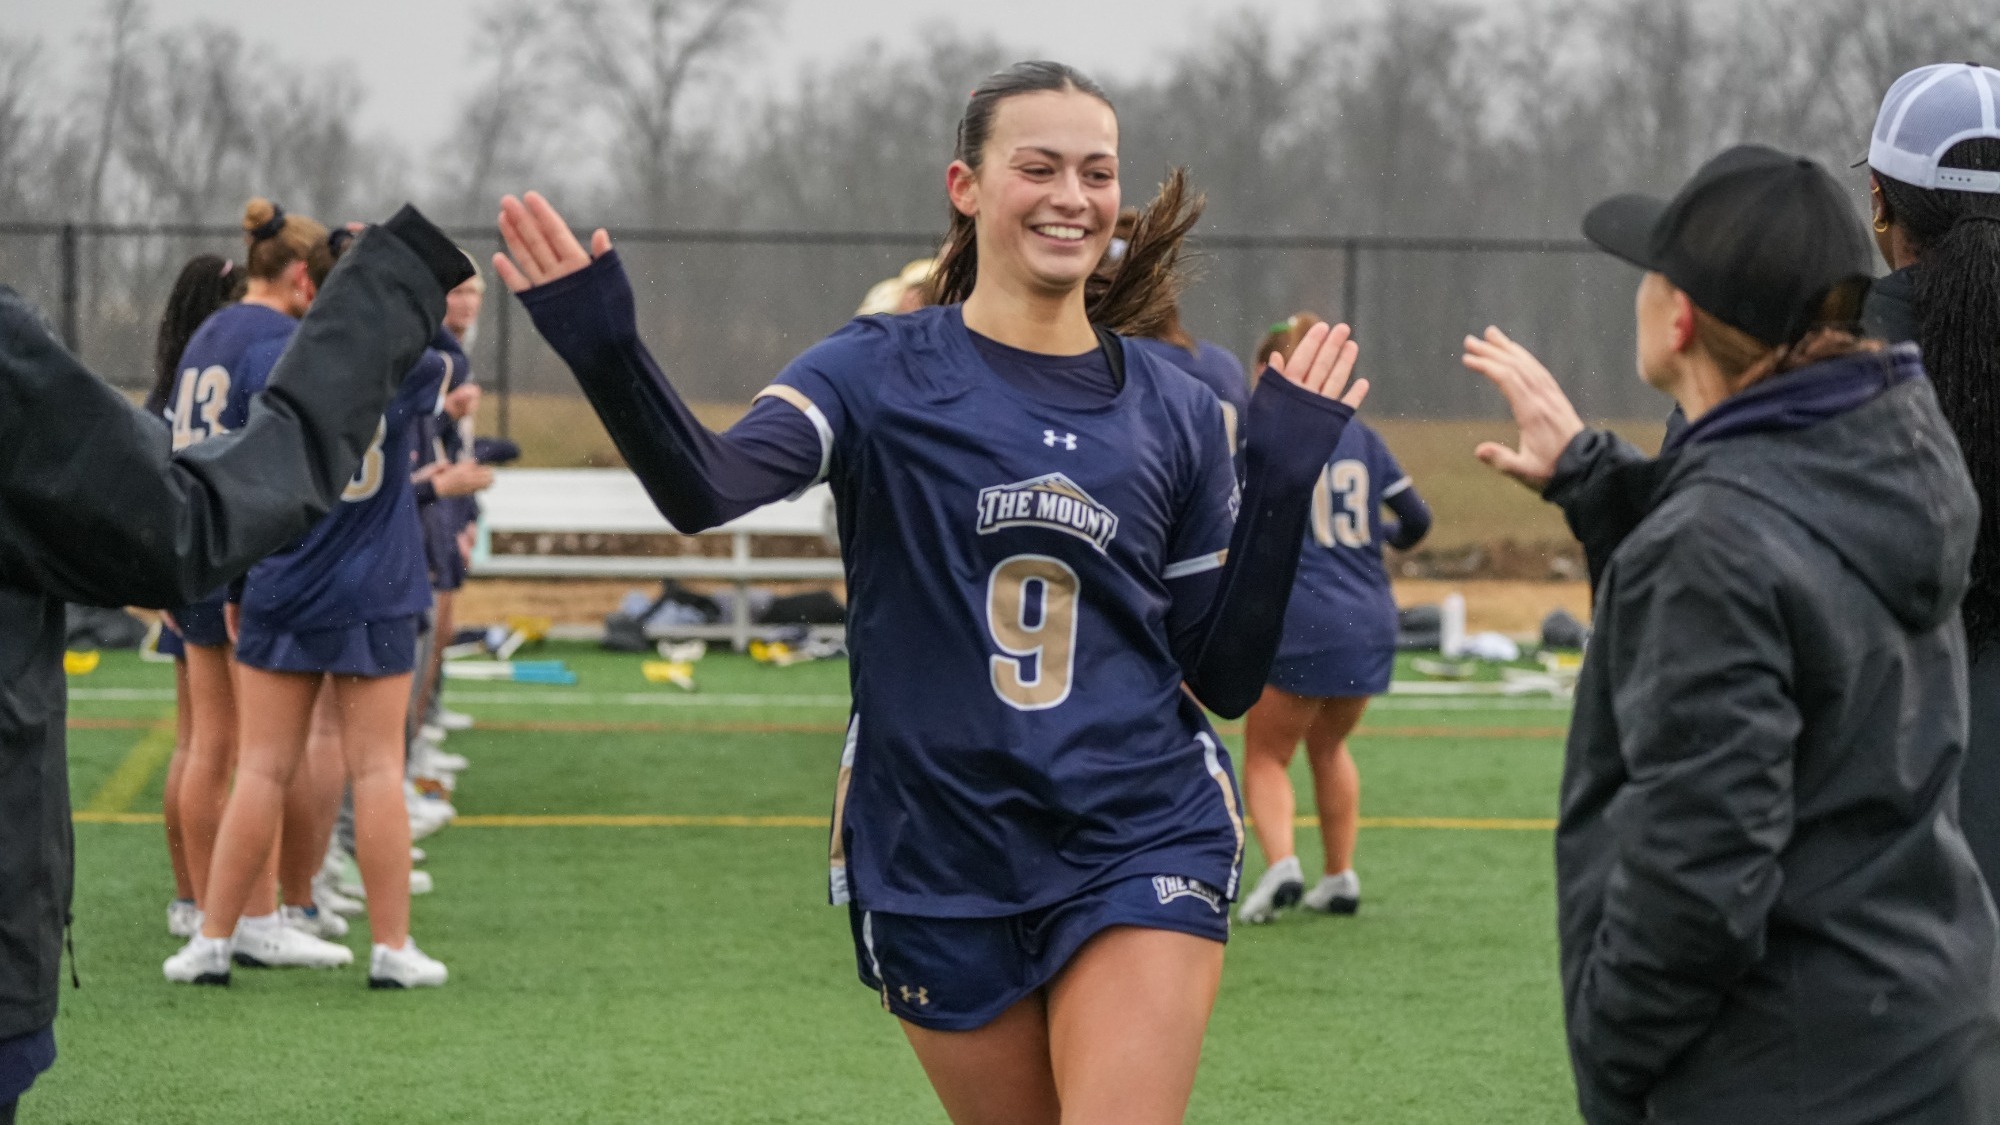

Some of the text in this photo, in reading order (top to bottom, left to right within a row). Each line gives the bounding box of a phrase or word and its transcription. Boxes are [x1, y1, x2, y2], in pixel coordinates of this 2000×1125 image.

[171, 364, 231, 452] 43
[983, 490, 1113, 547] THE MOUNT
[1311, 459, 1371, 548] 13
[986, 553, 1081, 711] 9
